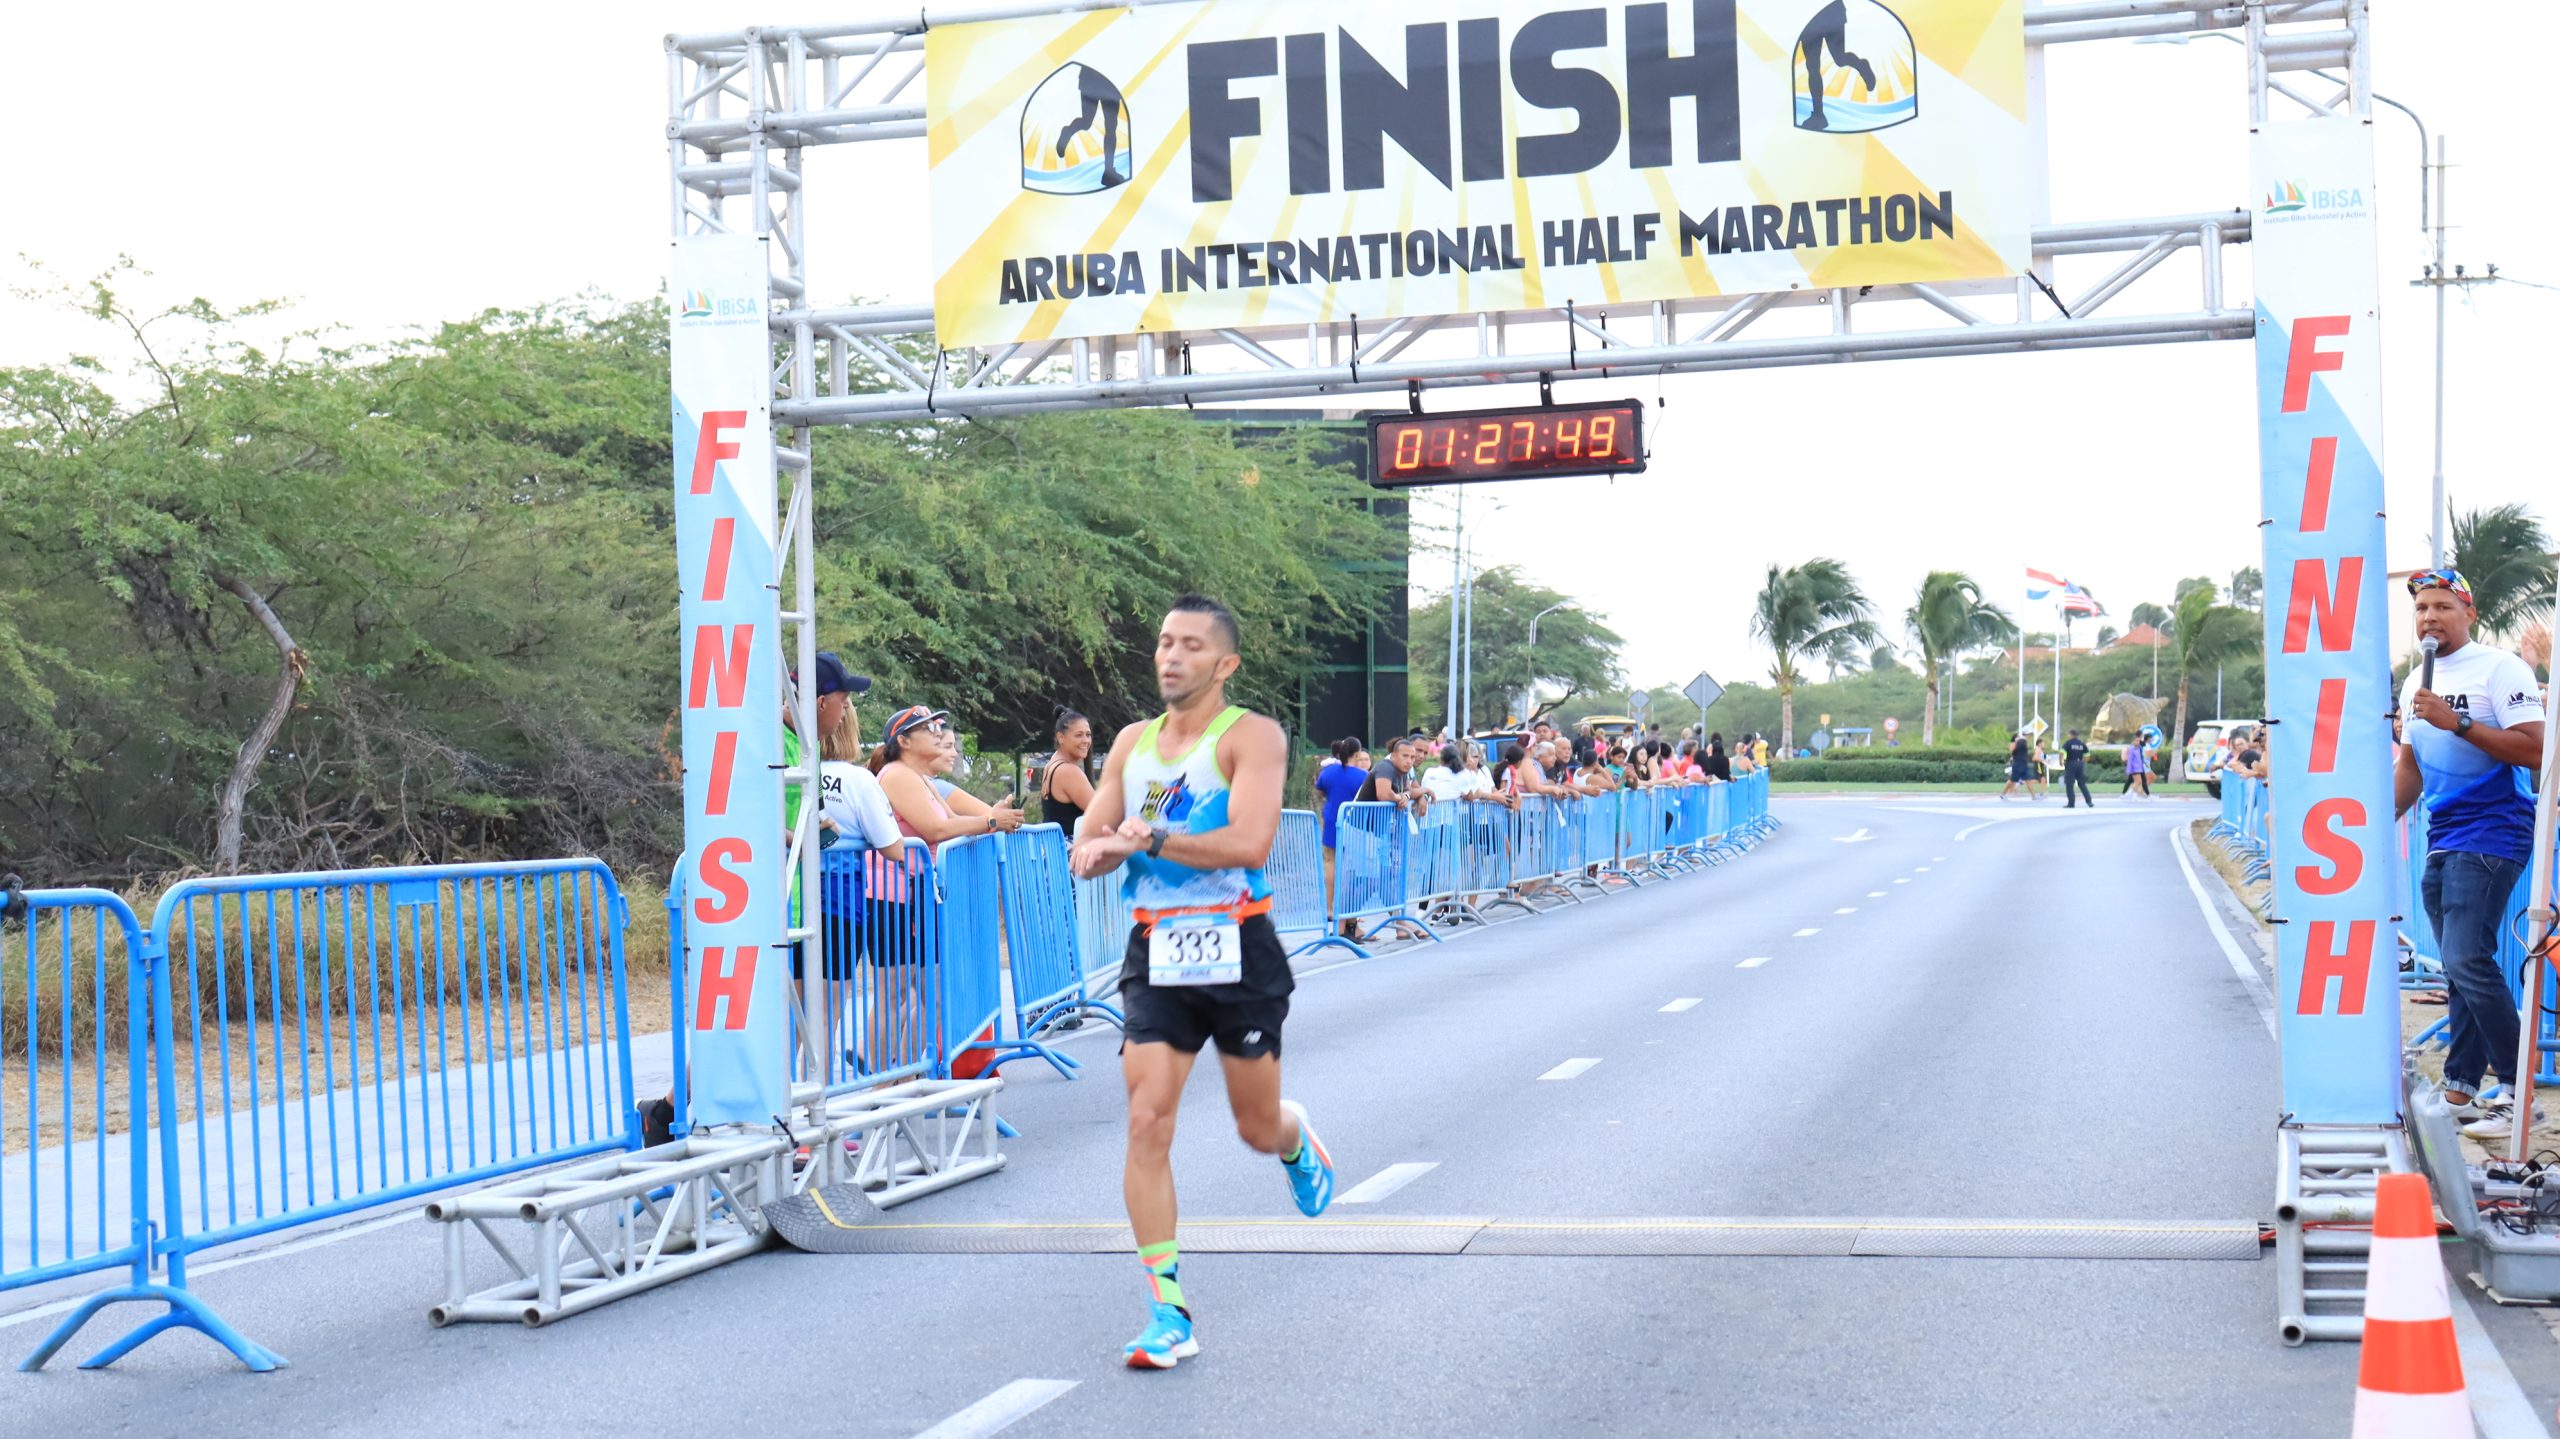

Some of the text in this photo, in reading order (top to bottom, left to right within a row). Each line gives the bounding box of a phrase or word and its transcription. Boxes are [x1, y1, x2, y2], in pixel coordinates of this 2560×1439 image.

[1188, 0, 1741, 203] FINISH
[999, 190, 1954, 305] ARUBA INTERNATIONAL HALF MARATHON
[1394, 415, 1617, 470] 01:27:49
[689, 410, 760, 1030] FINISH
[2281, 315, 2376, 1016] FINISH
[824, 794, 843, 803] Activo
[1167, 929, 1222, 964] 333
